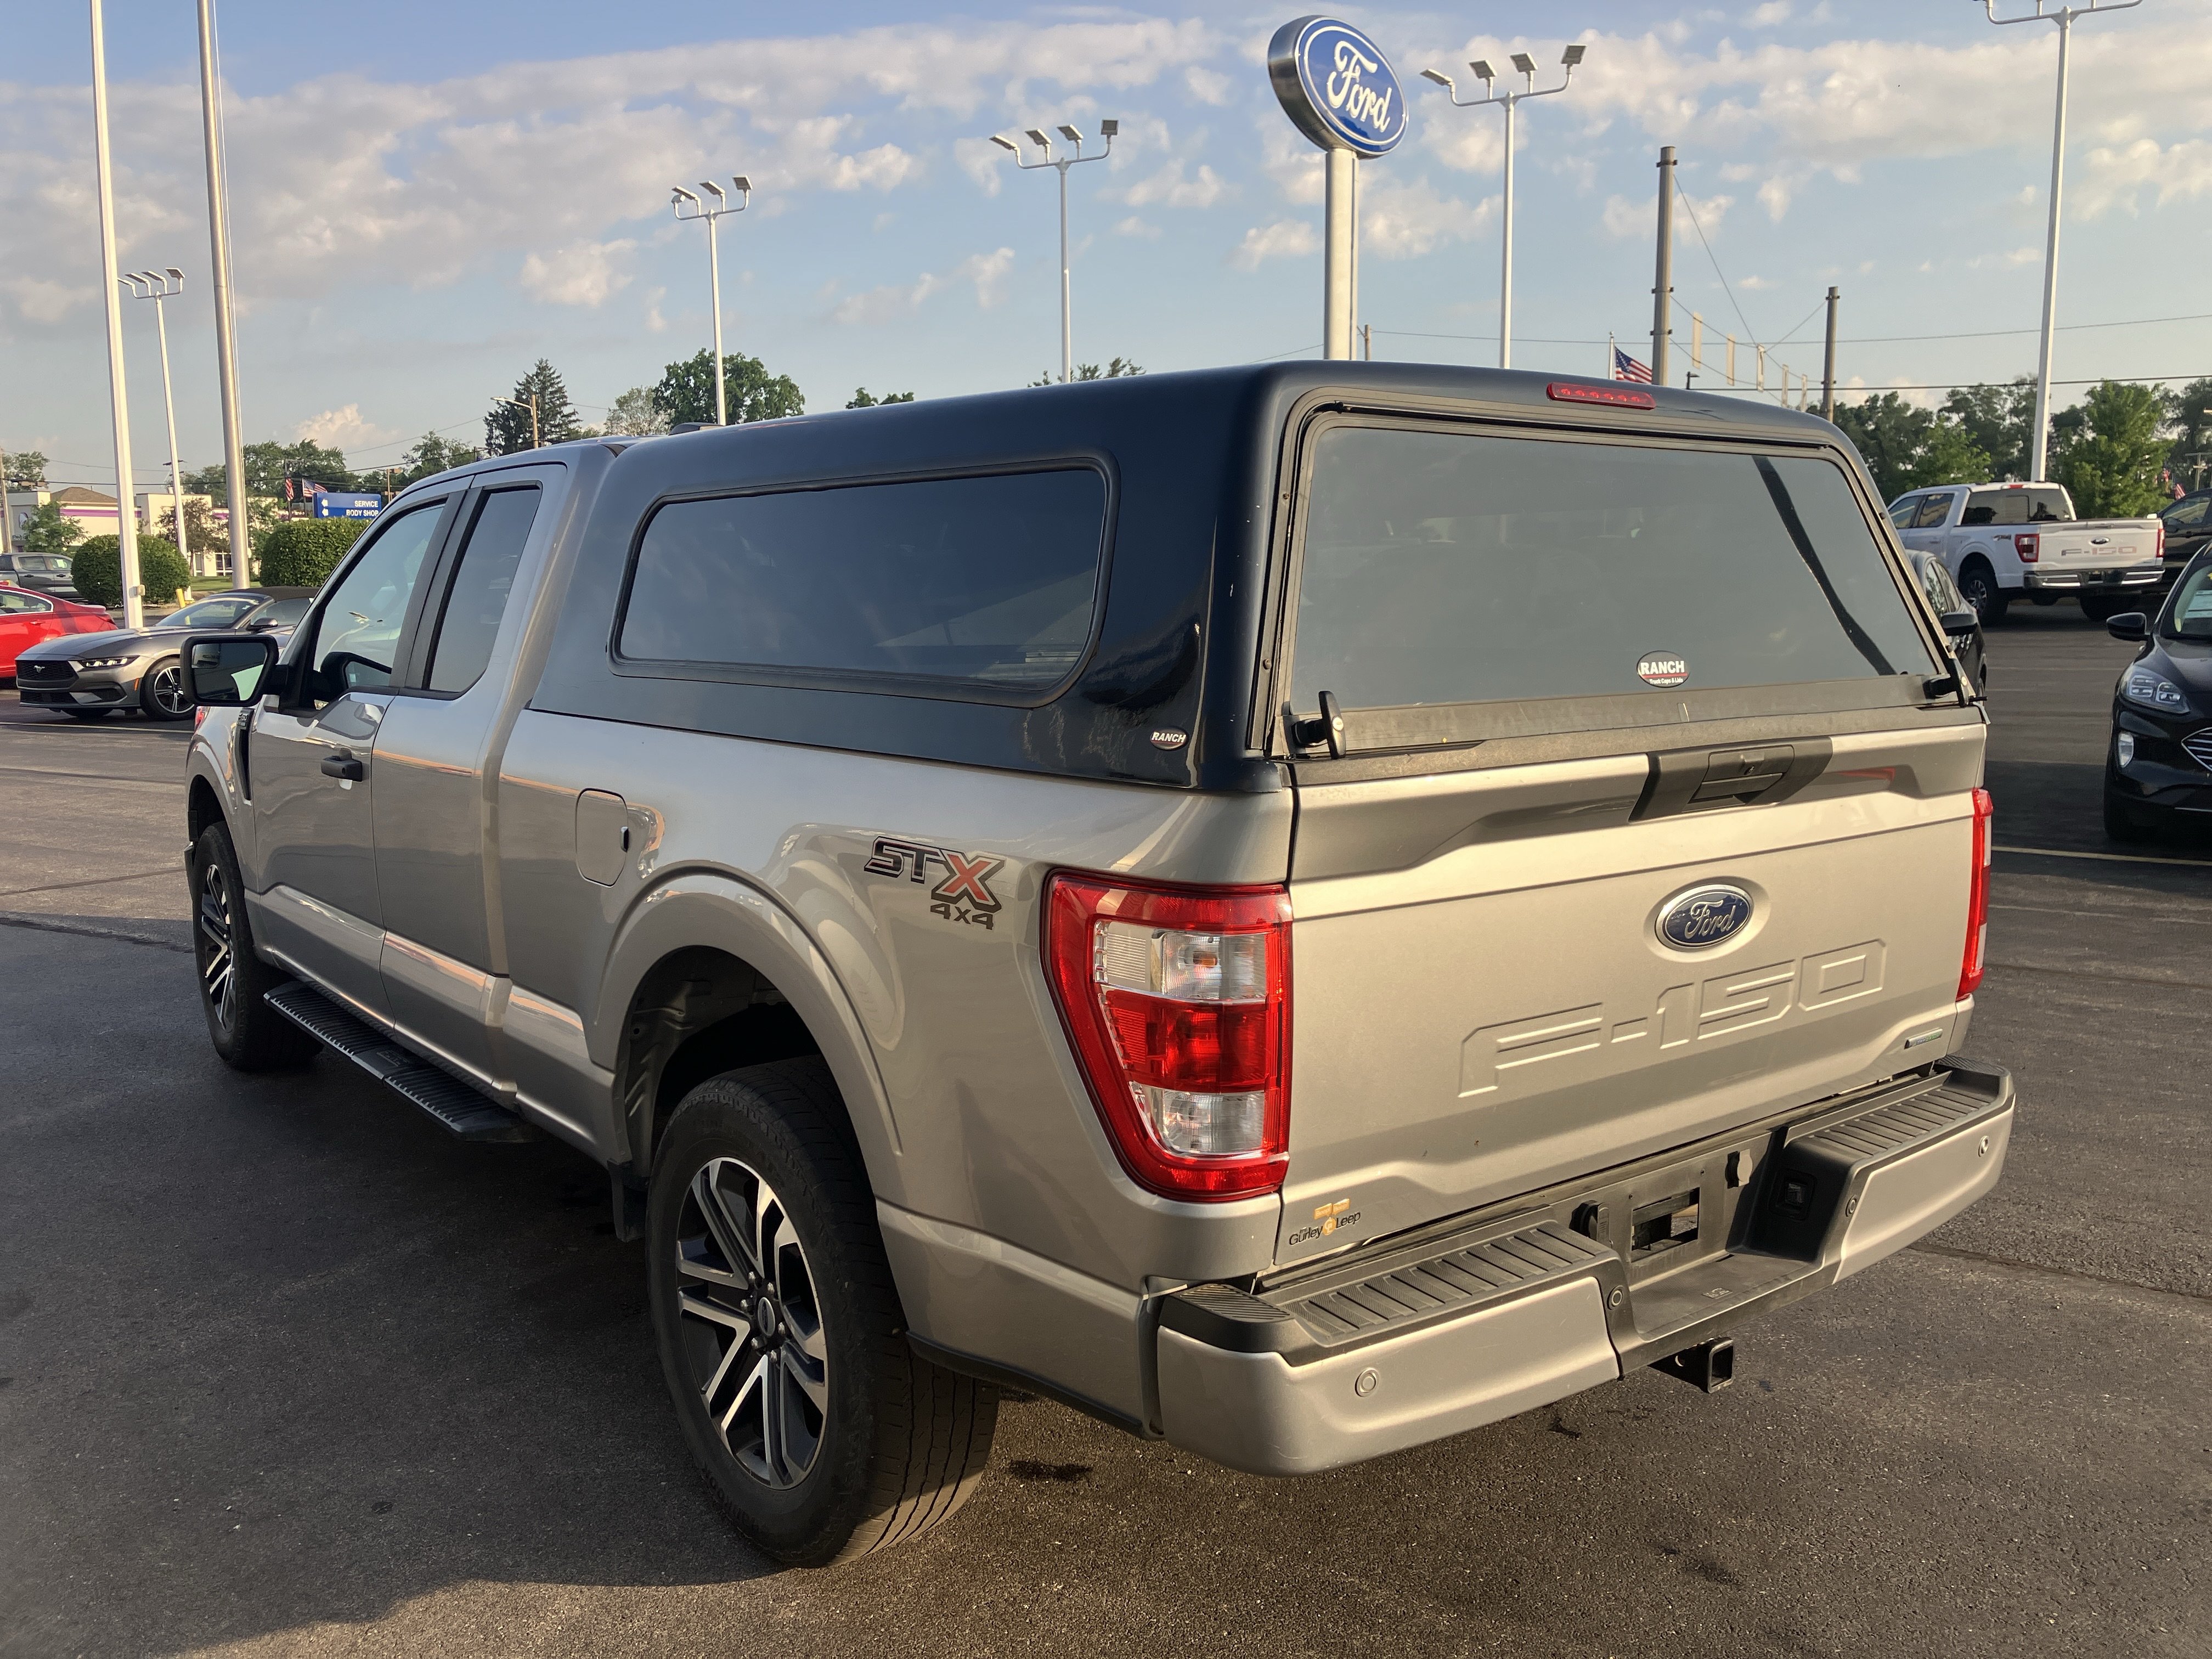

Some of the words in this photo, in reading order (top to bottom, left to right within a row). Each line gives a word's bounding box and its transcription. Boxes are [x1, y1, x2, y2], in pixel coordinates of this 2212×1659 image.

[1327, 41, 1392, 133] Ford
[2061, 546, 2137, 556] F-150
[1640, 660, 1685, 675] RANCH
[1151, 731, 1187, 743] RANCH
[864, 836, 1006, 913] STX
[1684, 899, 1736, 940] Ford
[1458, 938, 1887, 1098] F-150
[1289, 1225, 1323, 1246] Gurley
[1336, 1211, 1361, 1229] Leep
